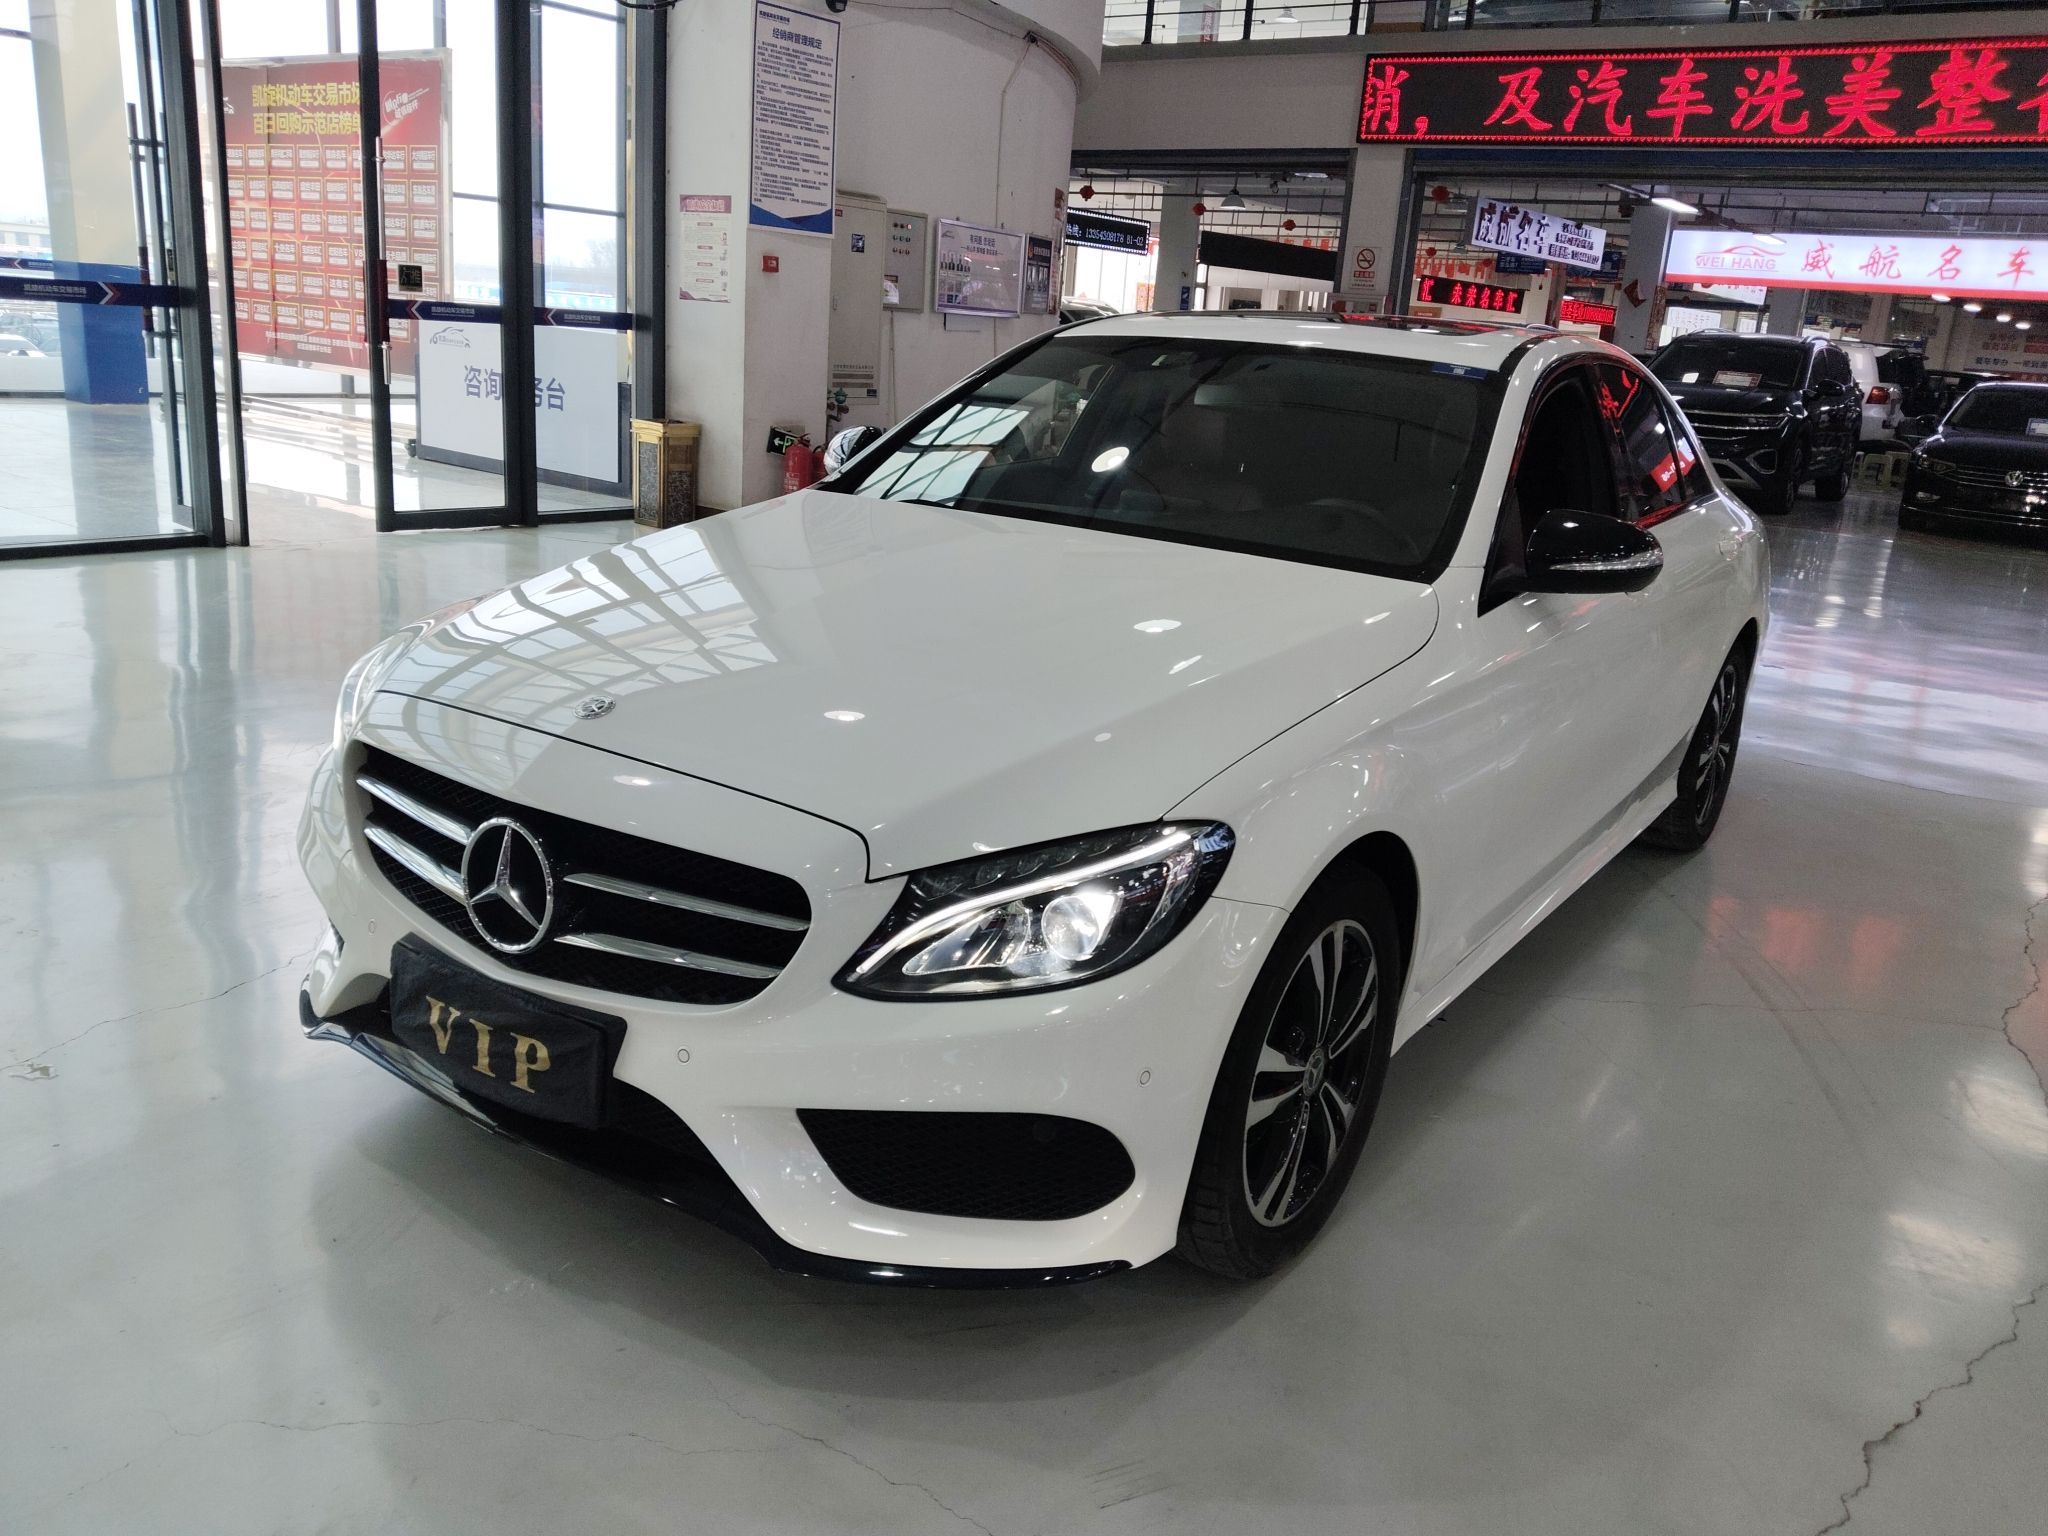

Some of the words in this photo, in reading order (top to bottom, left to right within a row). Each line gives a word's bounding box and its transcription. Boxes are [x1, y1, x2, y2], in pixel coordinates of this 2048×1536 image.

[772, 27, 822, 50] 经销商管理规定
[1696, 255, 1725, 268] WEI
[1732, 257, 1777, 270] HANG
[1801, 239, 2034, 287] 威航名车
[464, 364, 566, 412] 咨询务台
[426, 995, 551, 1094] VIP
